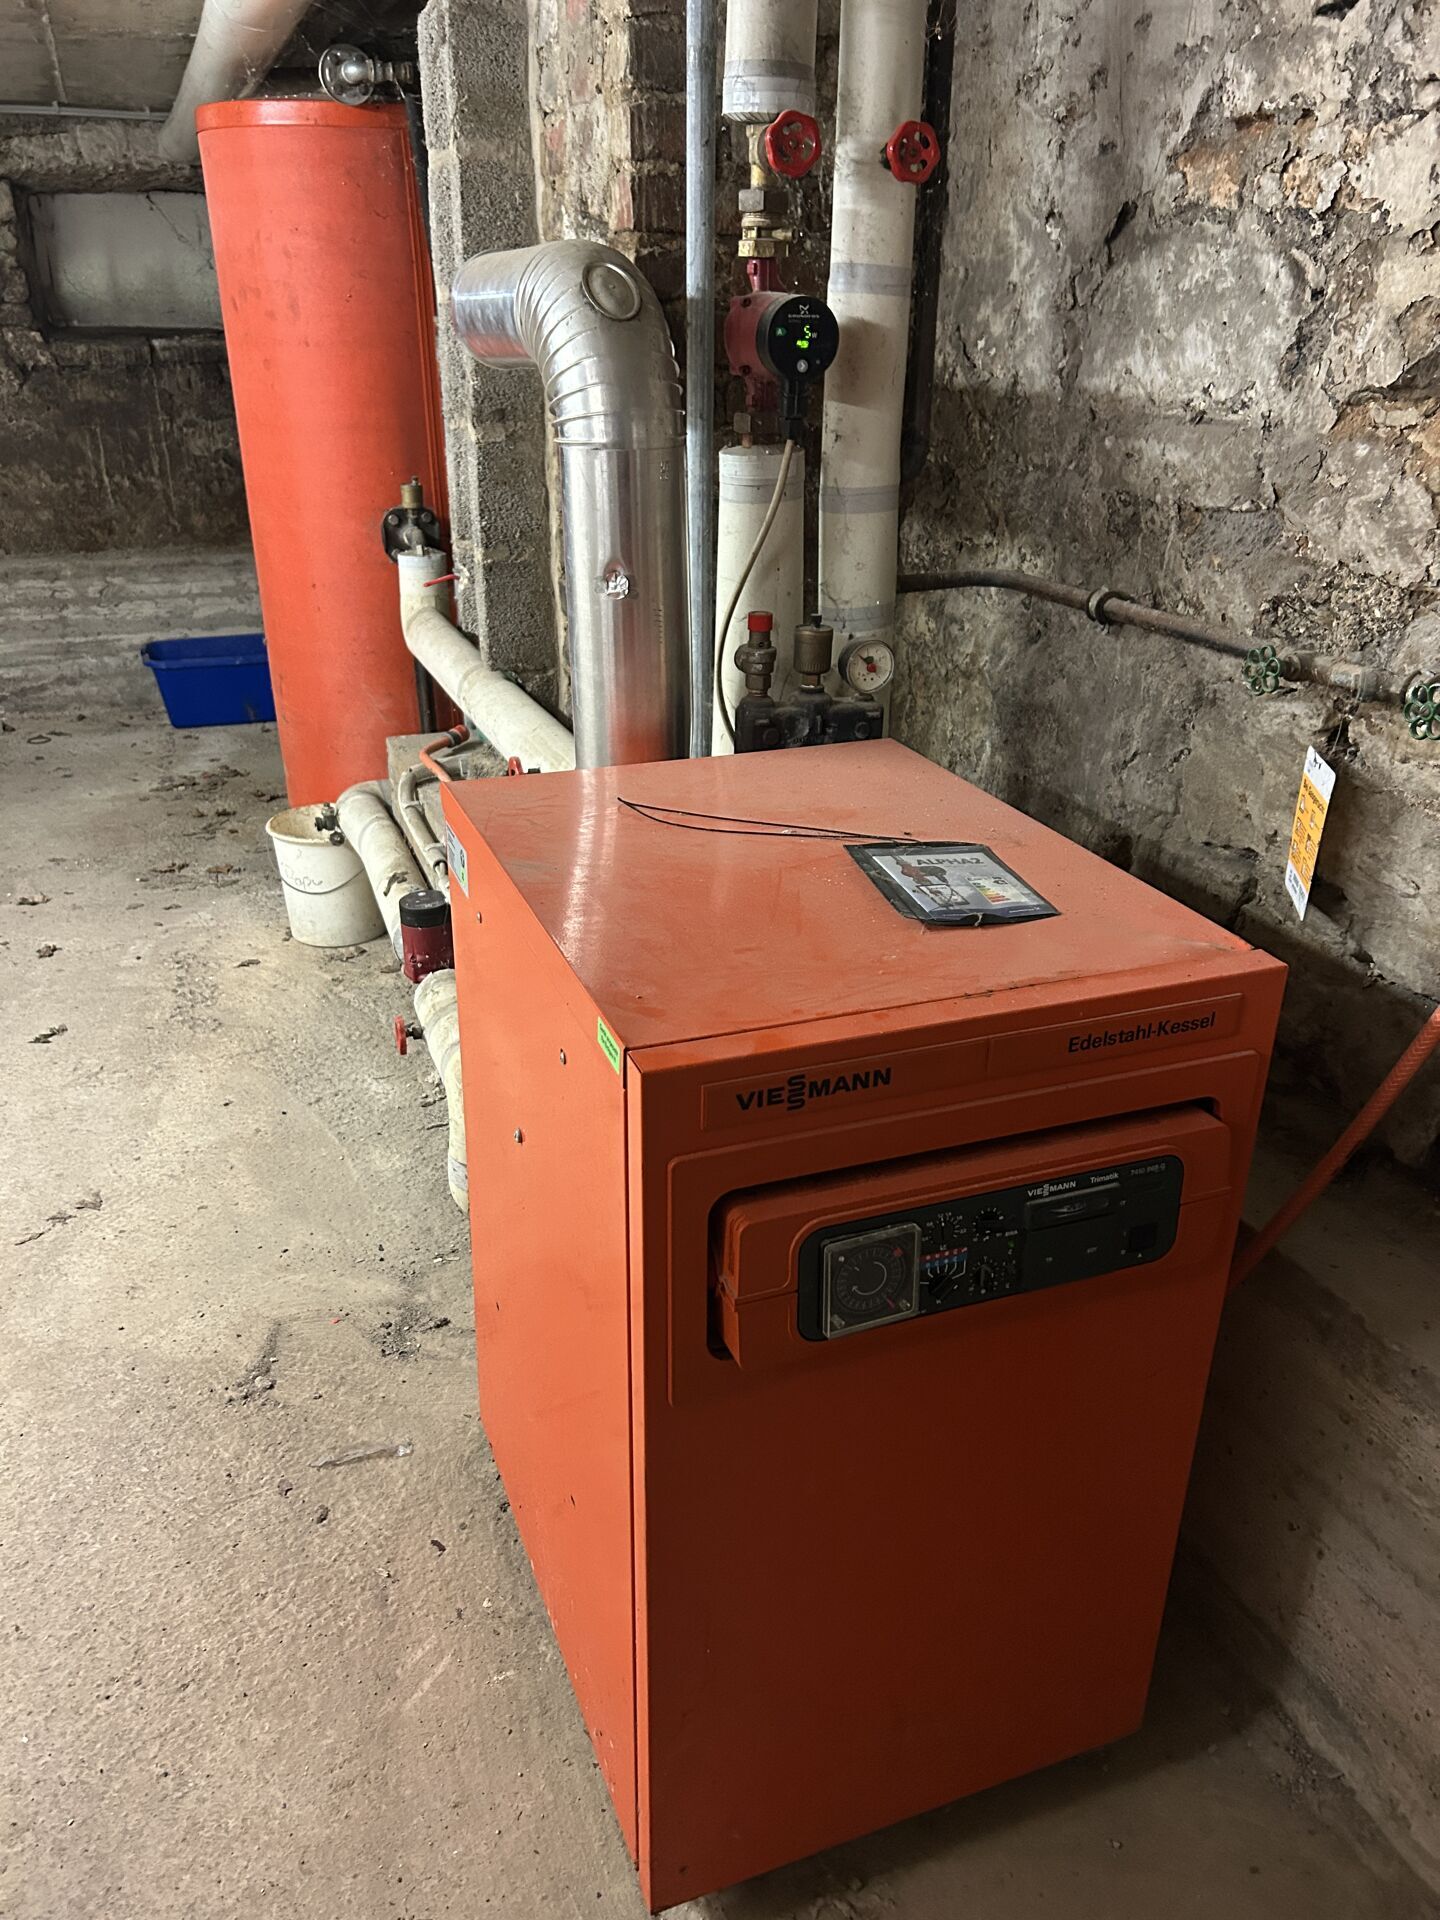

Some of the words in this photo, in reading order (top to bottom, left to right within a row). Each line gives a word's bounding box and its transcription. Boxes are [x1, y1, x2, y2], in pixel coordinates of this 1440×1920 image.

[916, 857, 985, 866] ALPHA2
[1067, 1012, 1216, 1054] Edelstahl-Kessel
[736, 1067, 892, 1111] VIESSMANN
[1026, 1181, 1077, 1197] VIESSMANN
[1089, 1172, 1120, 1184] Trimatik
